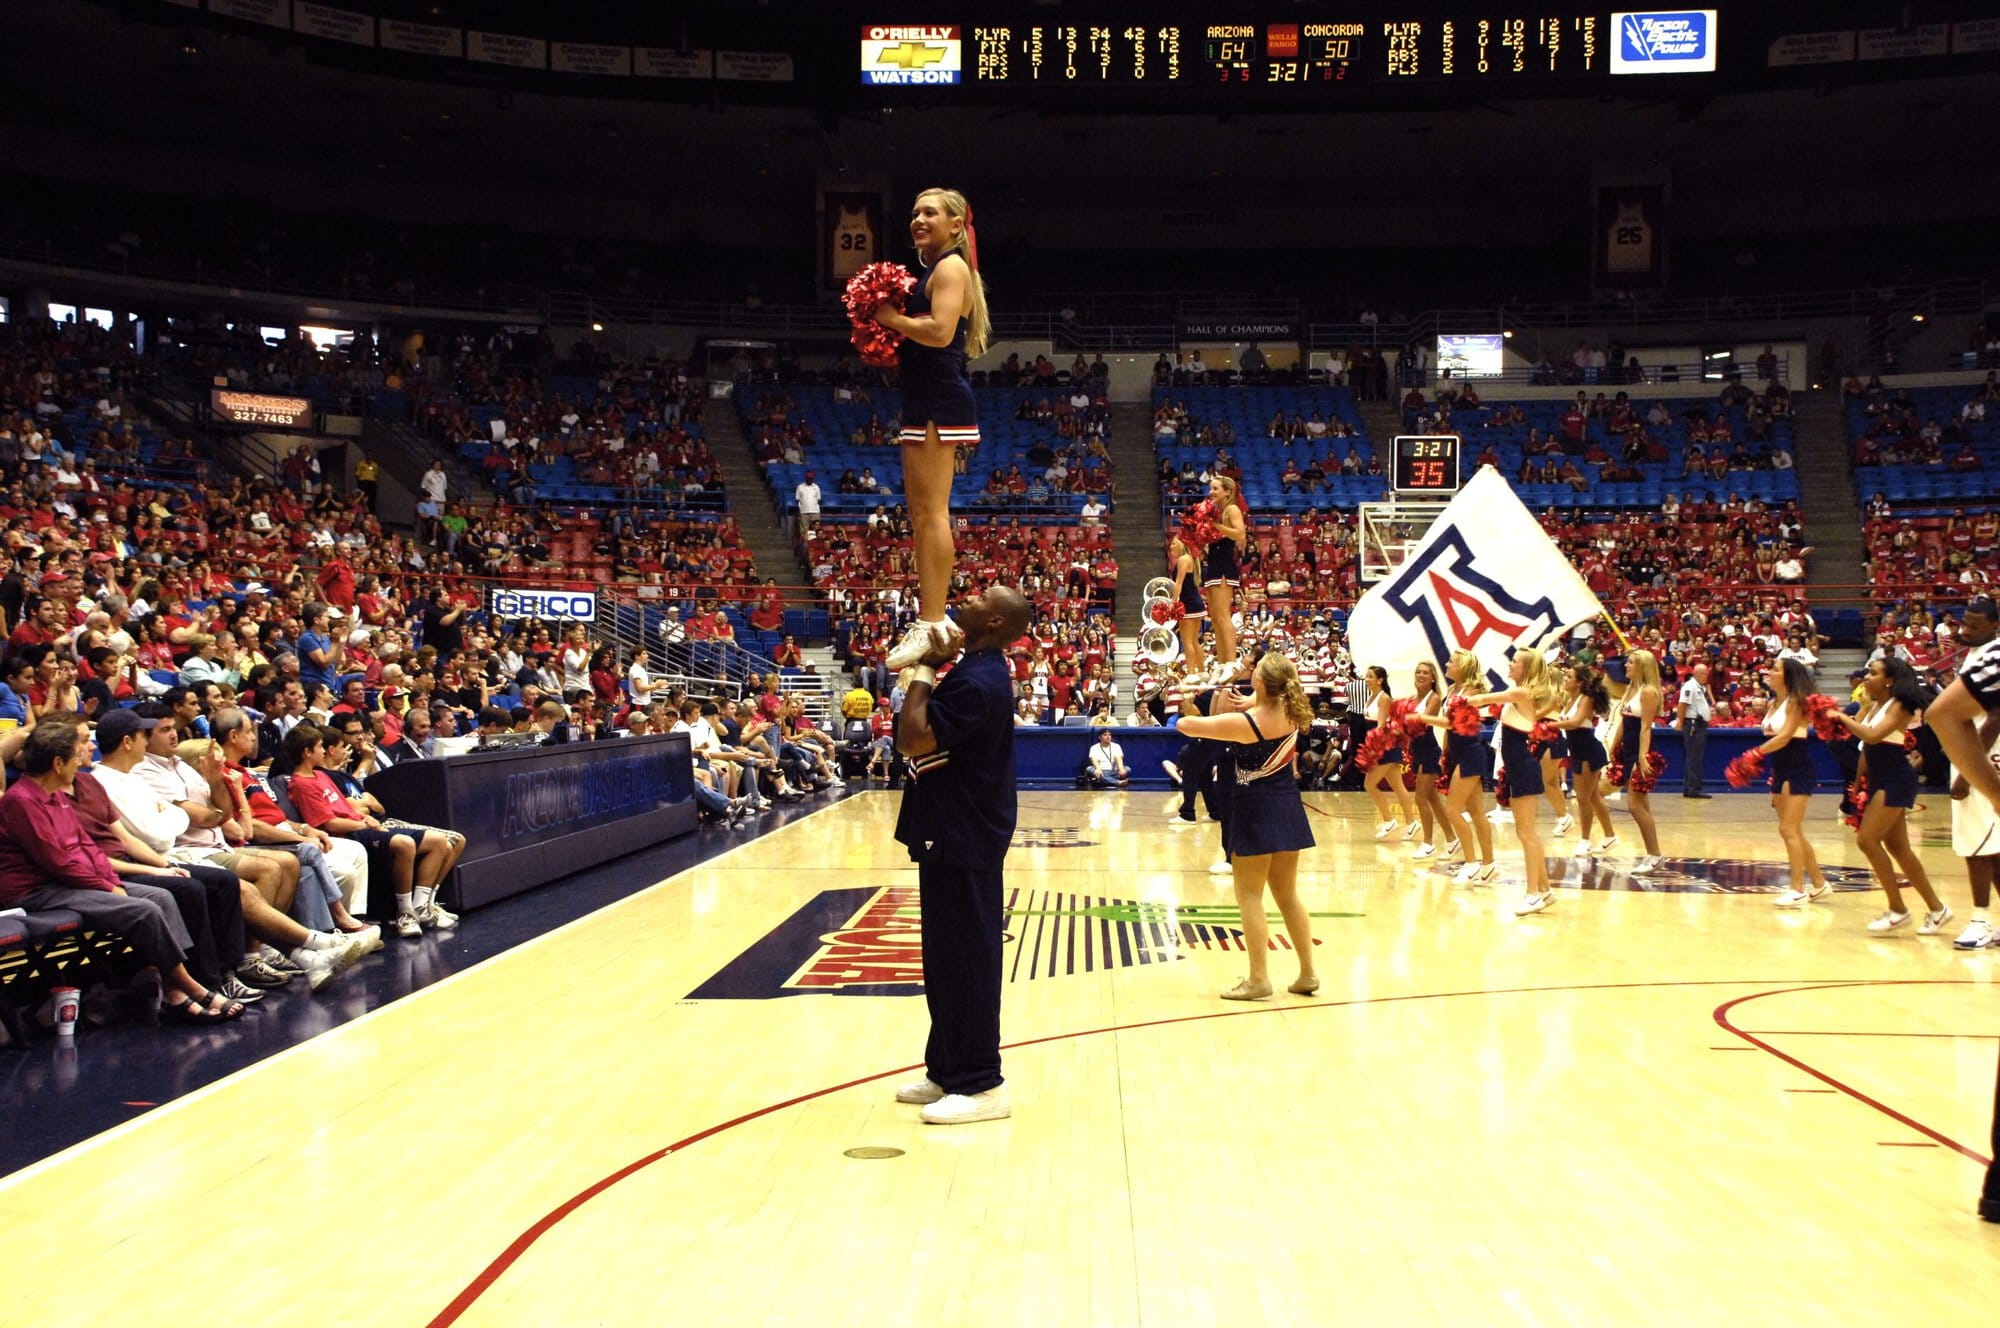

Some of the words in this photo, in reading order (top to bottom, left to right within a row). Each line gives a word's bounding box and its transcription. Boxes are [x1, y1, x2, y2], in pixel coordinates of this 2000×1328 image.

[1207, 25, 1254, 38] ARIZONA
[1304, 24, 1364, 37] CONCORDIA
[1384, 22, 1421, 36] PLYR
[1443, 21, 1454, 34] 6
[1478, 20, 1488, 32] 9
[1504, 19, 1524, 32] 10
[1540, 18, 1560, 31] 12
[1575, 17, 1595, 30] 15
[870, 27, 952, 40] O'RIELLY
[975, 28, 1010, 40] PLYR
[1032, 28, 1042, 40] 5
[1058, 27, 1077, 40] 13
[1090, 27, 1110, 40] 34
[1124, 27, 1145, 40] 42
[1159, 27, 1179, 40] 43
[981, 40, 1006, 53] PTS
[1391, 36, 1416, 48] PTS
[1220, 41, 1245, 60] 64
[1324, 40, 1350, 59] 50
[1388, 49, 1418, 62] RBS
[979, 54, 1008, 66] RBS
[979, 67, 1008, 79] FLS
[1065, 66, 1076, 79] 0
[1134, 66, 1145, 79] 0
[1169, 66, 1179, 79] 3
[1268, 62, 1309, 81] 3:21
[1388, 62, 1418, 75] FLS
[870, 71, 953, 83] WATSON
[841, 233, 866, 251] 32
[1187, 325, 1211, 334] HALL
[1215, 325, 1227, 334] OF
[1231, 325, 1289, 334] CHAMPIONS
[233, 410, 293, 424] 327-7463
[1413, 441, 1452, 457] 3:21
[1410, 461, 1445, 486] 35
[580, 511, 589, 520] 19
[1280, 518, 1290, 526] 21
[1629, 516, 1640, 525] 22
[956, 518, 968, 527] 20
[669, 587, 679, 597] 19
[495, 594, 592, 617] GEICO
